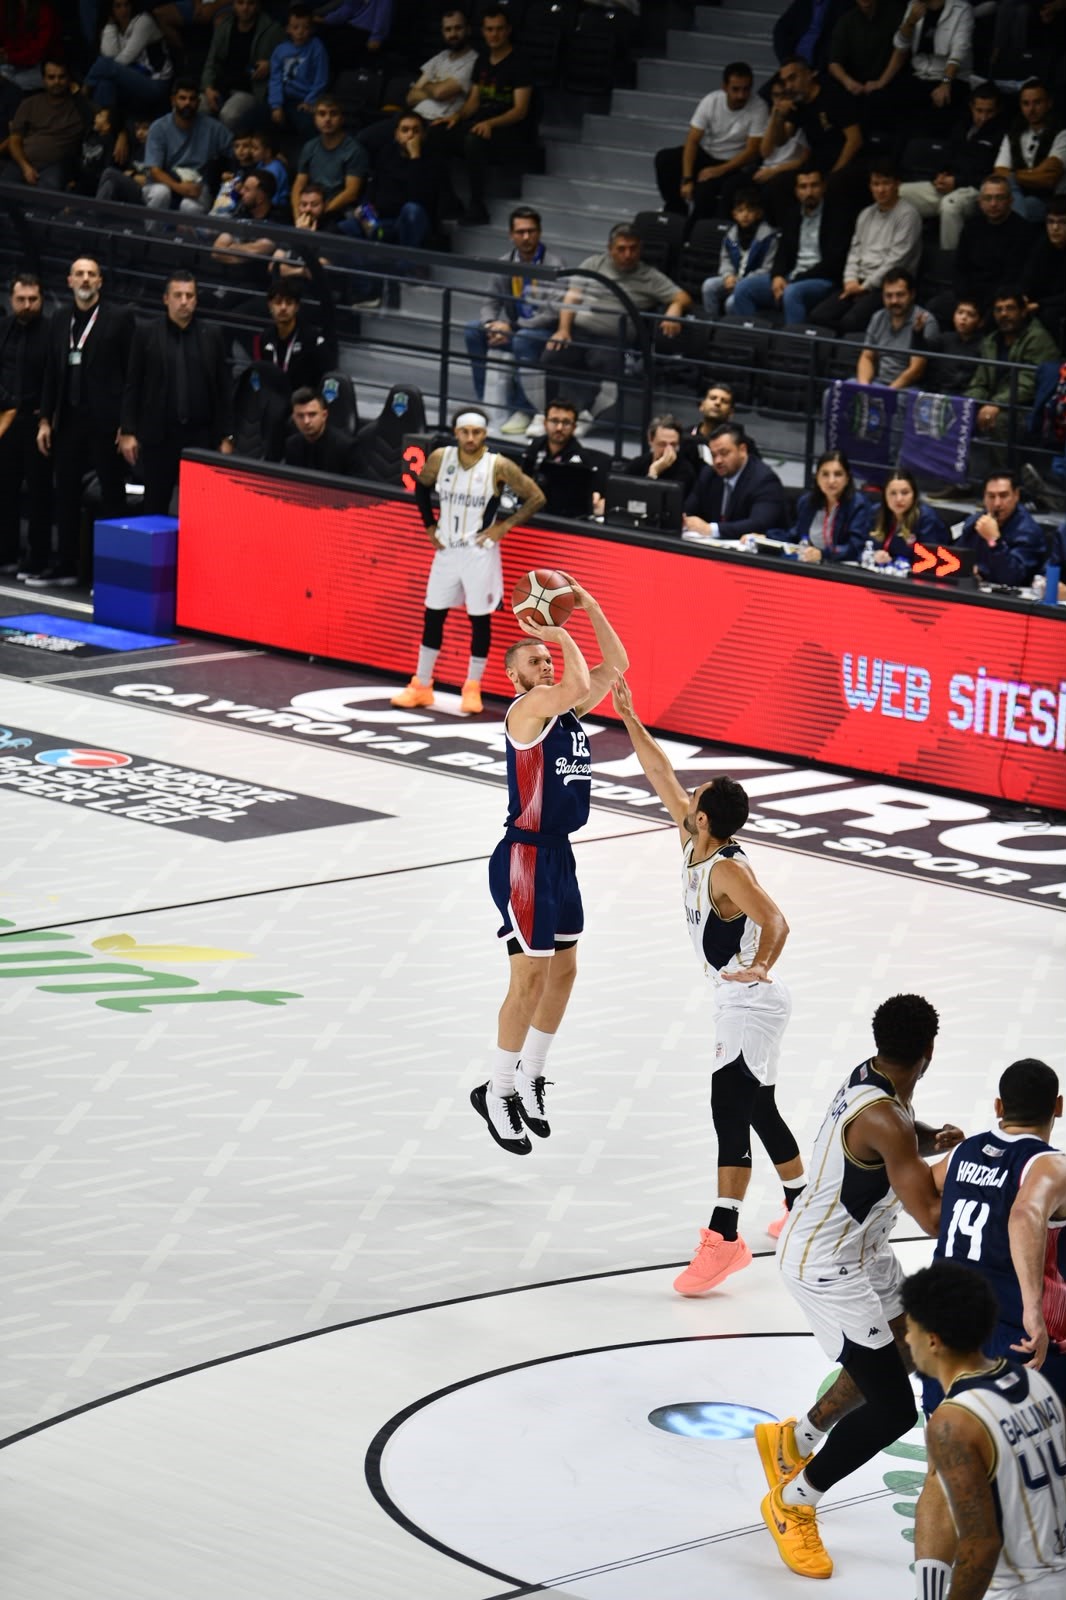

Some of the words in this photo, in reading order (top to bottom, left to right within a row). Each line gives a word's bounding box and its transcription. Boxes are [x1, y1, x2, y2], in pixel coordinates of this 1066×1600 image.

[453, 515, 460, 534] 1
[842, 652, 932, 722] WEB
[823, 836, 1032, 886] SPOR
[945, 1198, 990, 1261] 14
